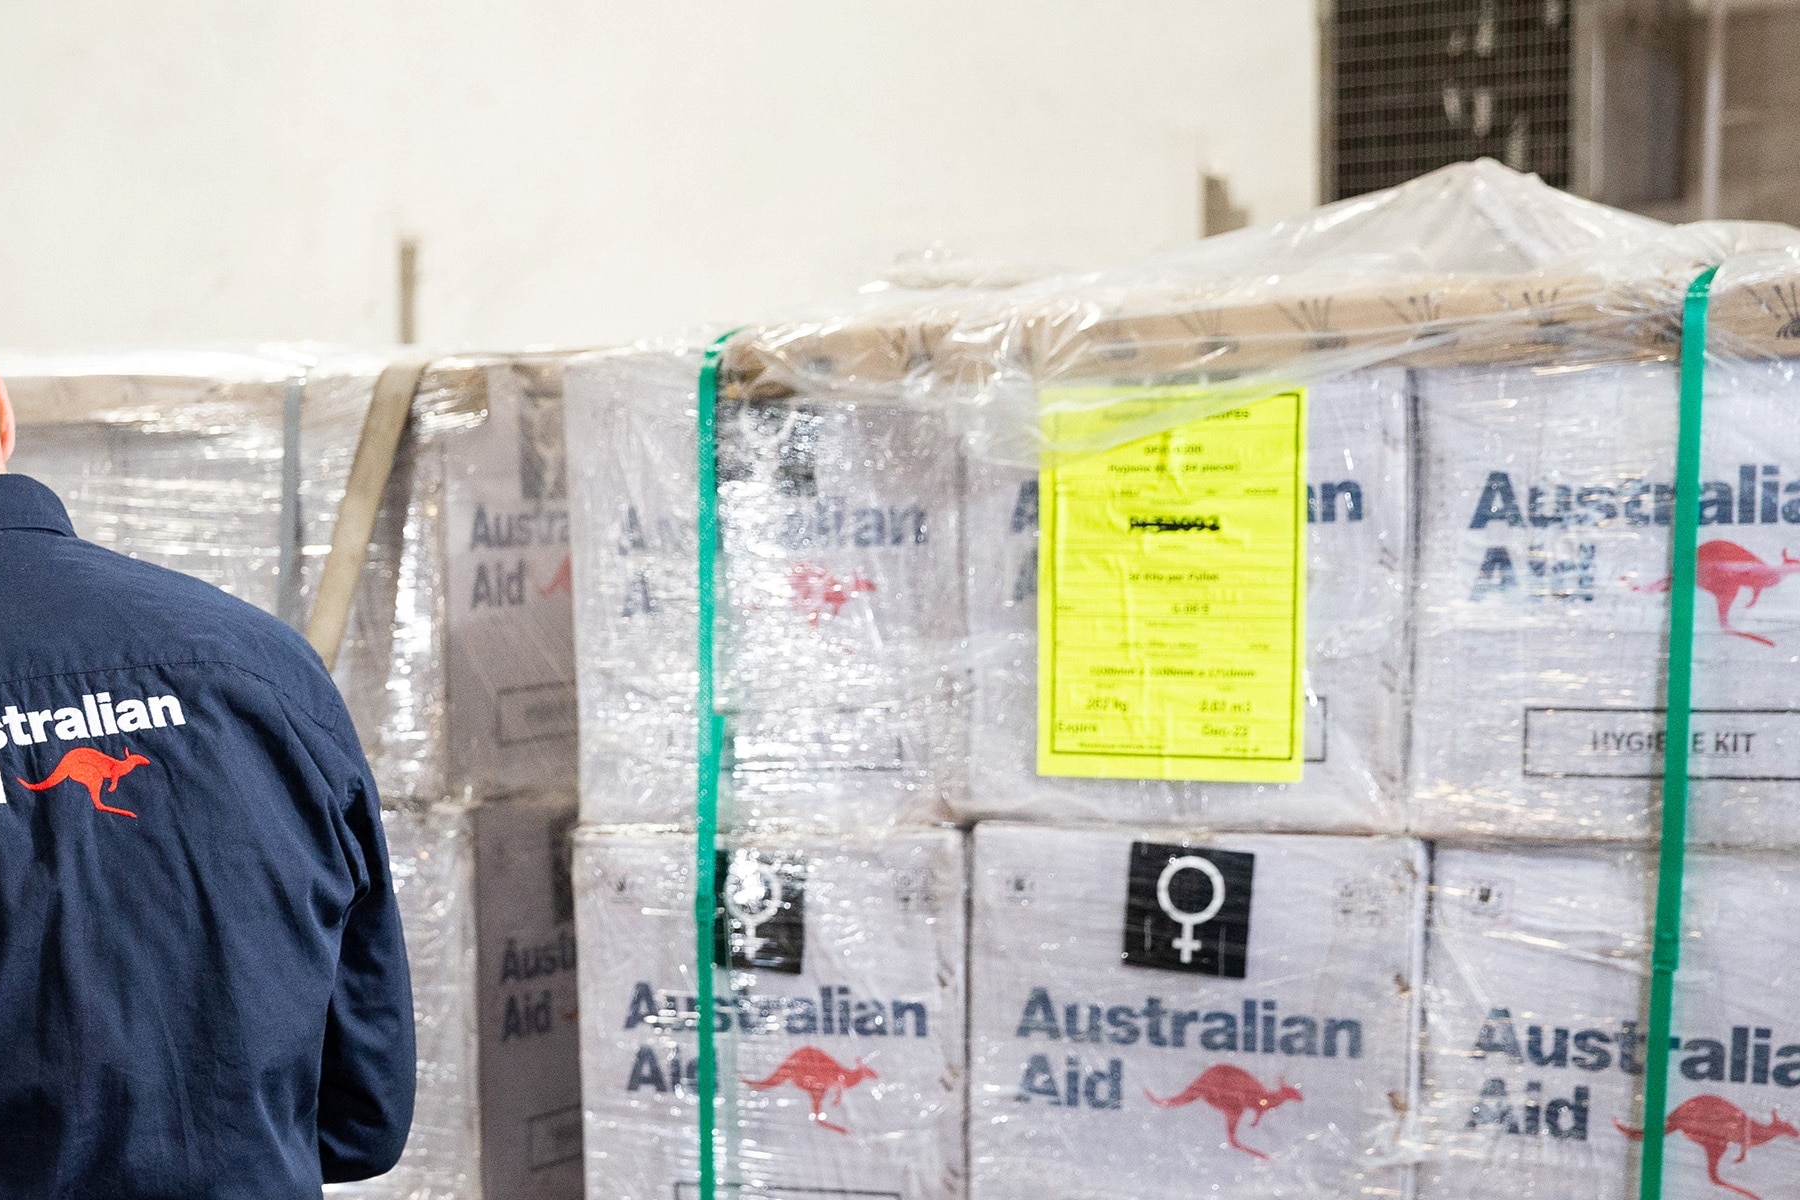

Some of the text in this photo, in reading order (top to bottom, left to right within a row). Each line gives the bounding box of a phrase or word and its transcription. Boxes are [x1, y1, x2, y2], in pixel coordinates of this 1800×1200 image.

[471, 557, 525, 609] Aid
[1715, 732, 1756, 754] KIT
[1015, 987, 1363, 1058] Australian
[1014, 1053, 1122, 1110] Aid
[1465, 1080, 1590, 1141] Aid
